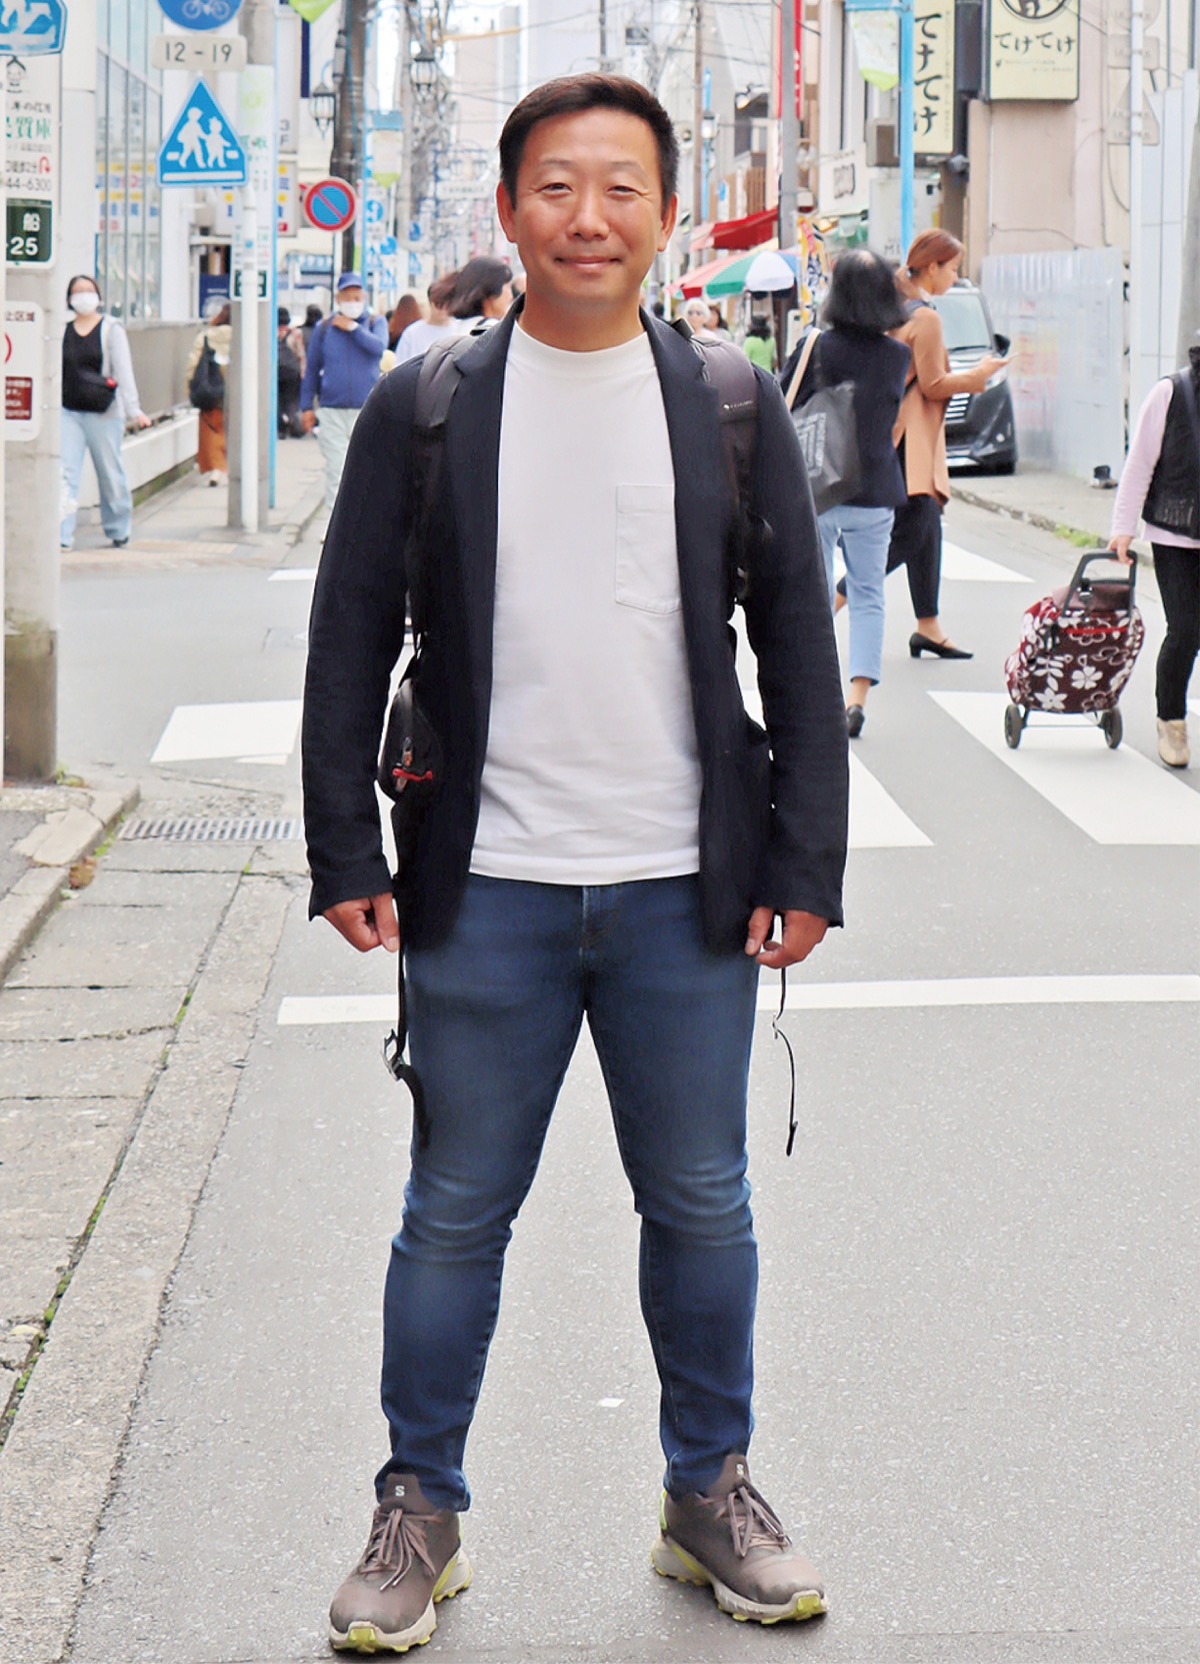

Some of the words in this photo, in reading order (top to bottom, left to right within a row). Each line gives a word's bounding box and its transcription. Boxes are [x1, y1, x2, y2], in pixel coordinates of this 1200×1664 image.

[994, 31, 1077, 55] てけてけ
[914, 12, 943, 137] てけてけ
[10, 236, 39, 256] 25
[737, 1463, 744, 1475] S
[395, 1485, 405, 1497] S
